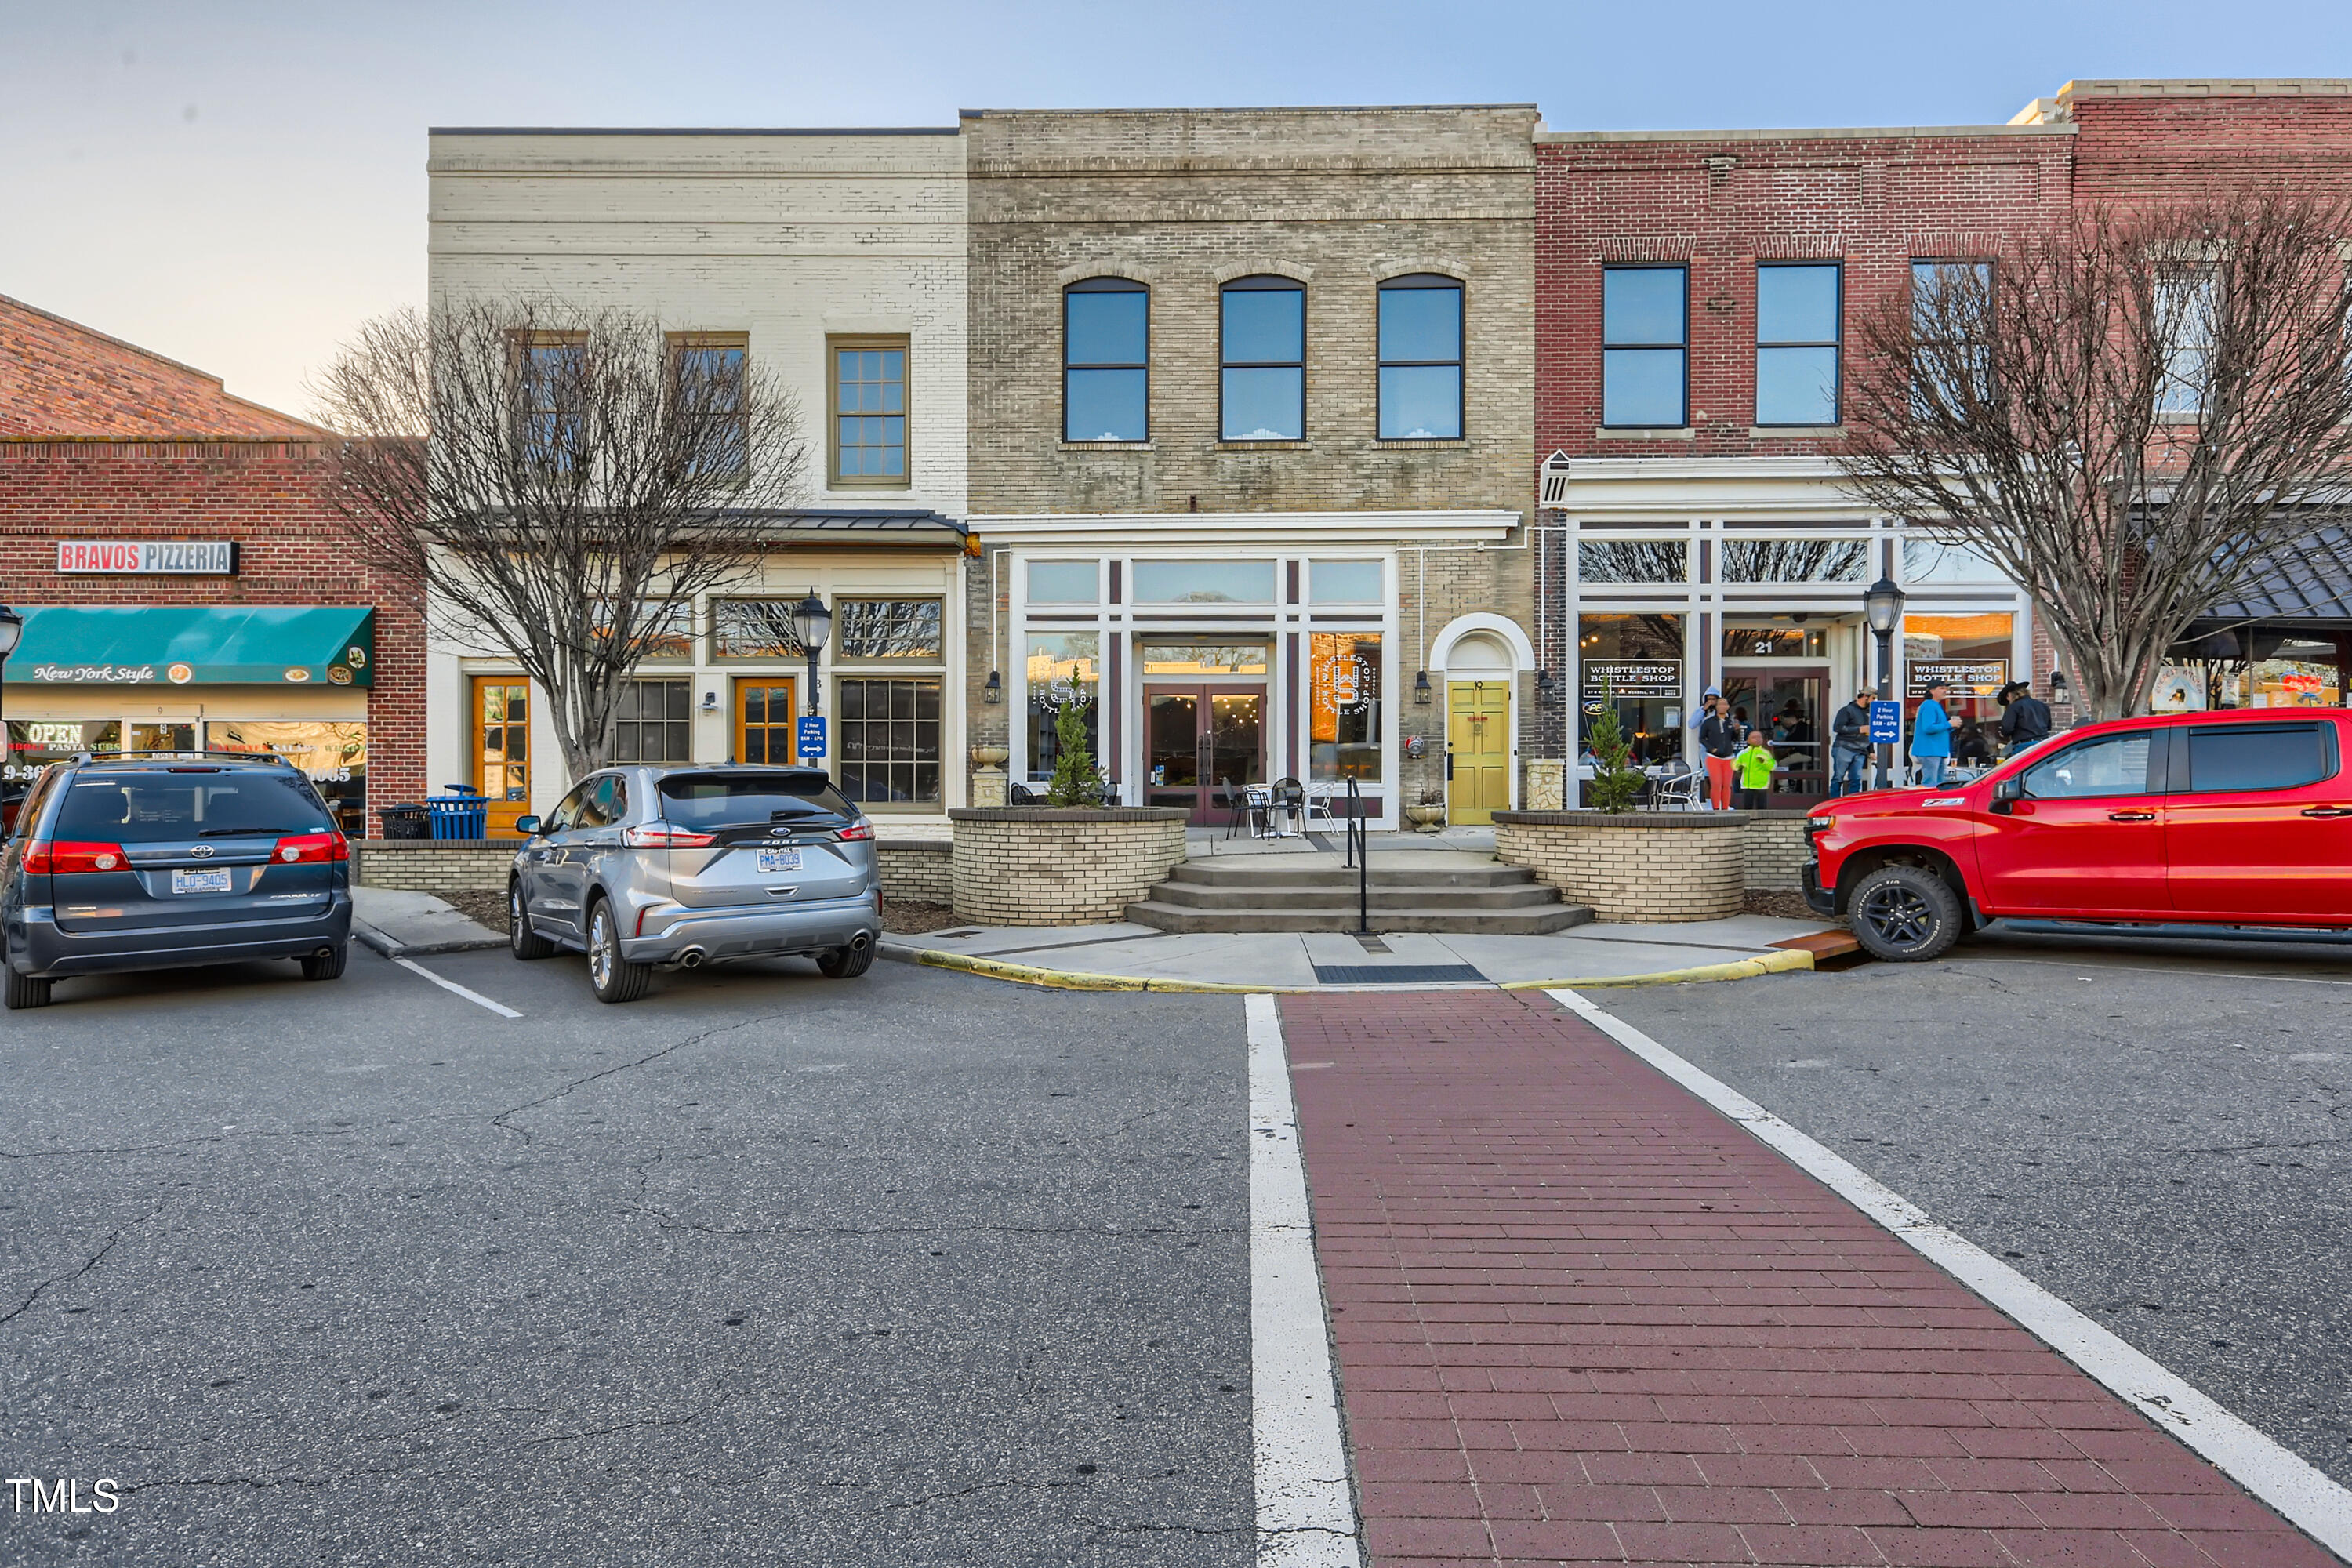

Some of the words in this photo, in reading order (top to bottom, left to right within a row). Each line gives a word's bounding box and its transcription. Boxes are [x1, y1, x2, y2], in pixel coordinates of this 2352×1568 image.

[61, 545, 139, 571] BRAVOS
[145, 544, 228, 571] PIZZERIA
[1755, 641, 1773, 654] 21
[34, 666, 74, 681] New
[74, 666, 115, 681] York
[114, 666, 154, 684] Style
[1323, 655, 1370, 681] WHISTLESTOP
[157, 706, 163, 715] 9
[1322, 690, 1350, 715] BOTTLE
[1353, 690, 1370, 715] SHOP
[28, 724, 83, 743] OPEN
